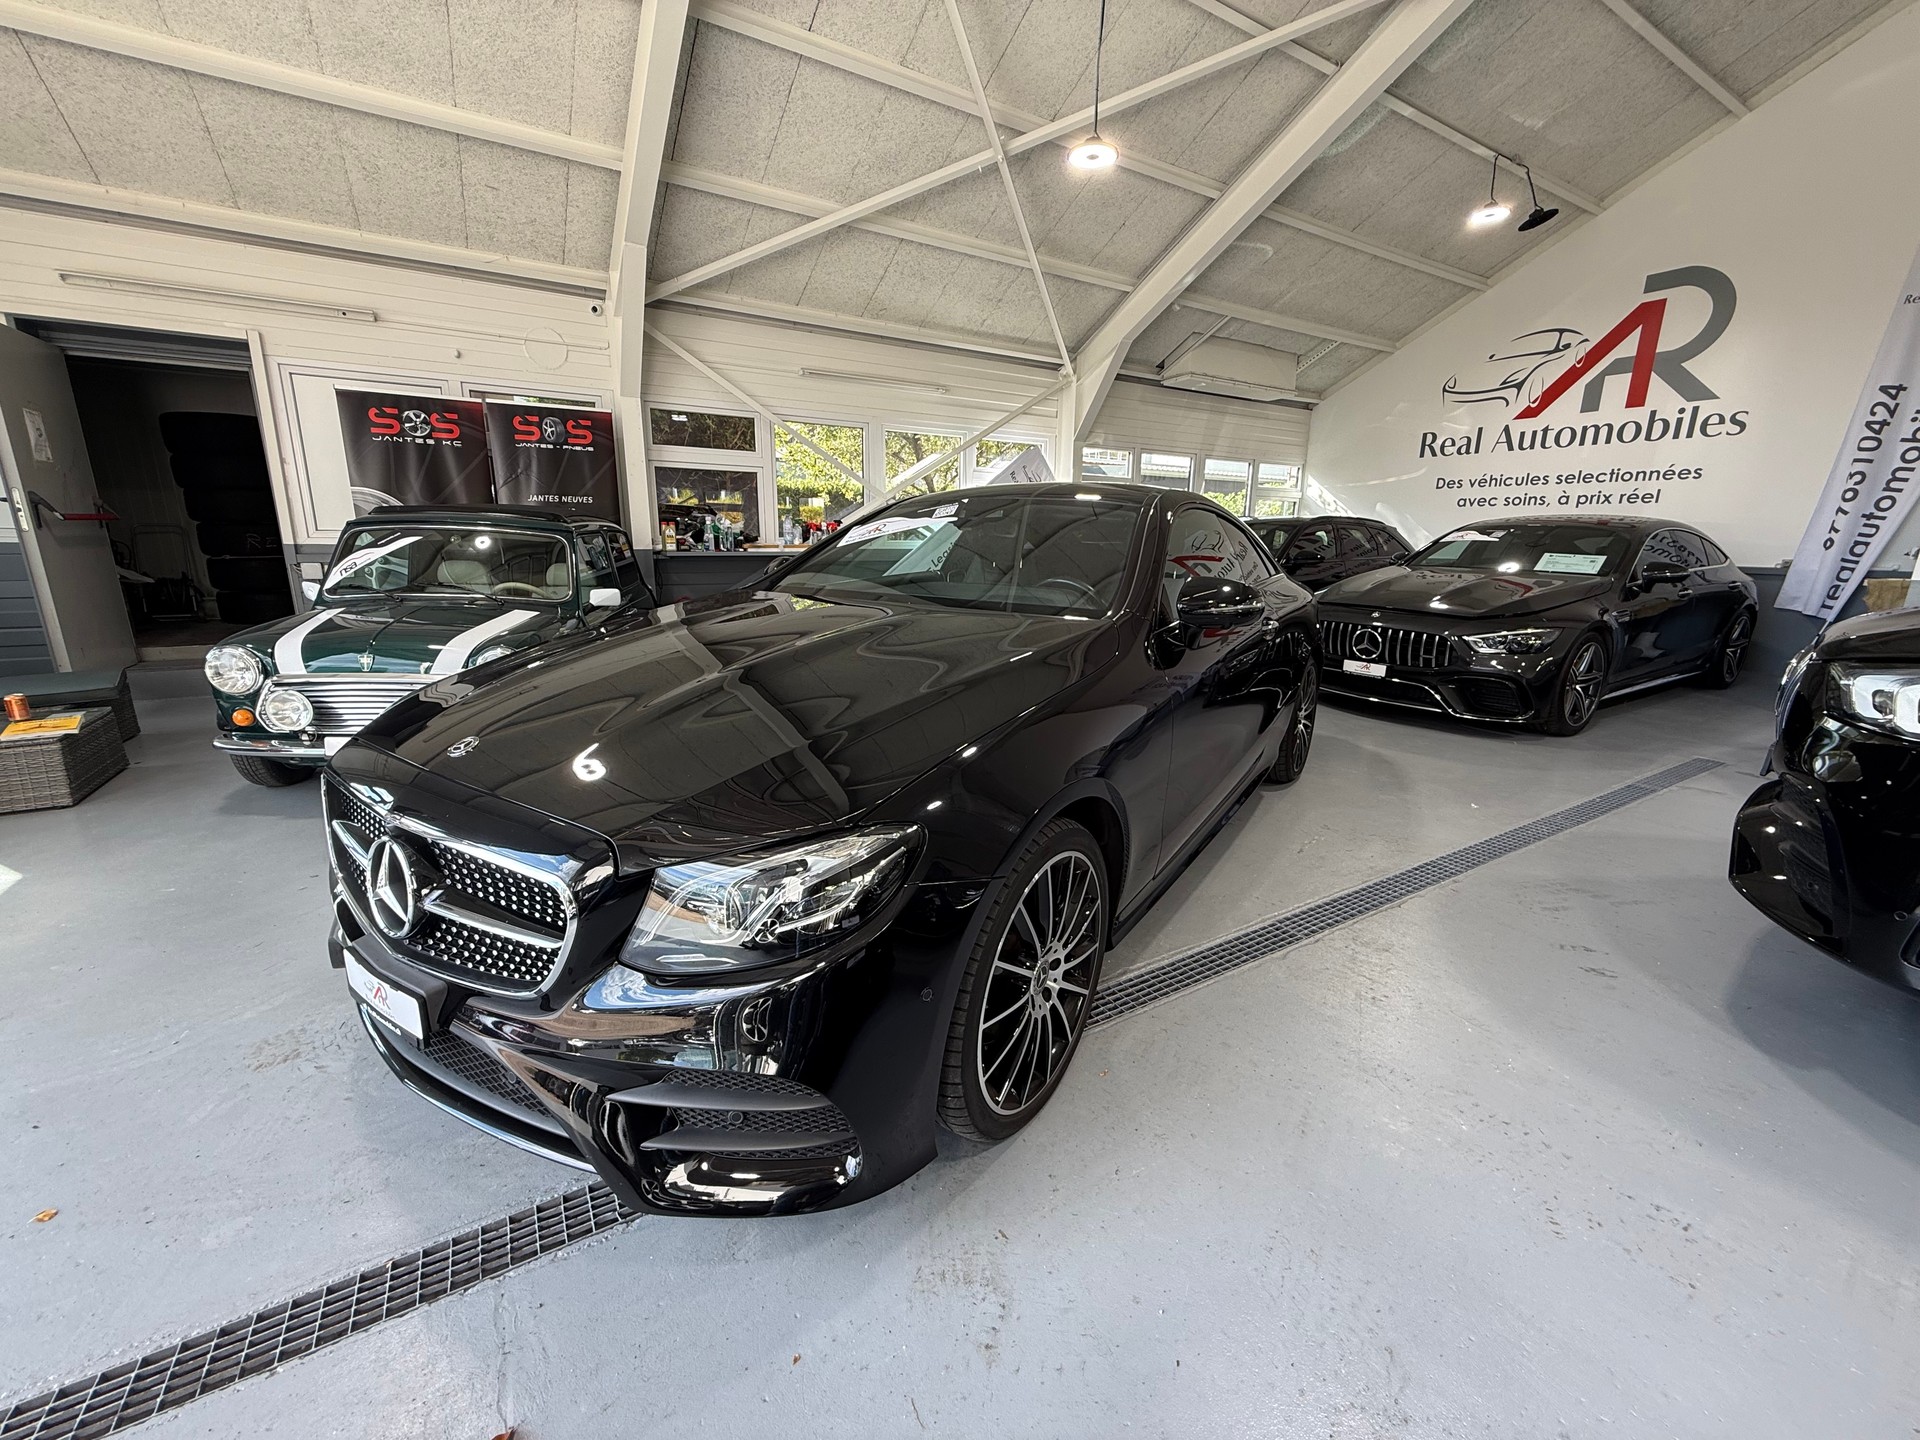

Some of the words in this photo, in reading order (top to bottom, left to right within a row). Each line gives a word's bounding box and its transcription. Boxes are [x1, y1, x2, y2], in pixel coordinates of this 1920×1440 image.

[372, 435, 435, 445] JANTES
[1418, 426, 1484, 459] Real
[1491, 405, 1749, 453] Automobiles
[1435, 477, 1464, 490] Des
[1468, 472, 1550, 490] véhicules
[1555, 463, 1703, 486] selectionnées
[528, 494, 560, 503] JANTES
[561, 496, 593, 504] NEUVES
[1456, 494, 1499, 508] avec
[1502, 492, 1551, 508] soins,
[1557, 489, 1571, 507] à
[1575, 490, 1613, 509] prix
[1618, 488, 1662, 505] réel
